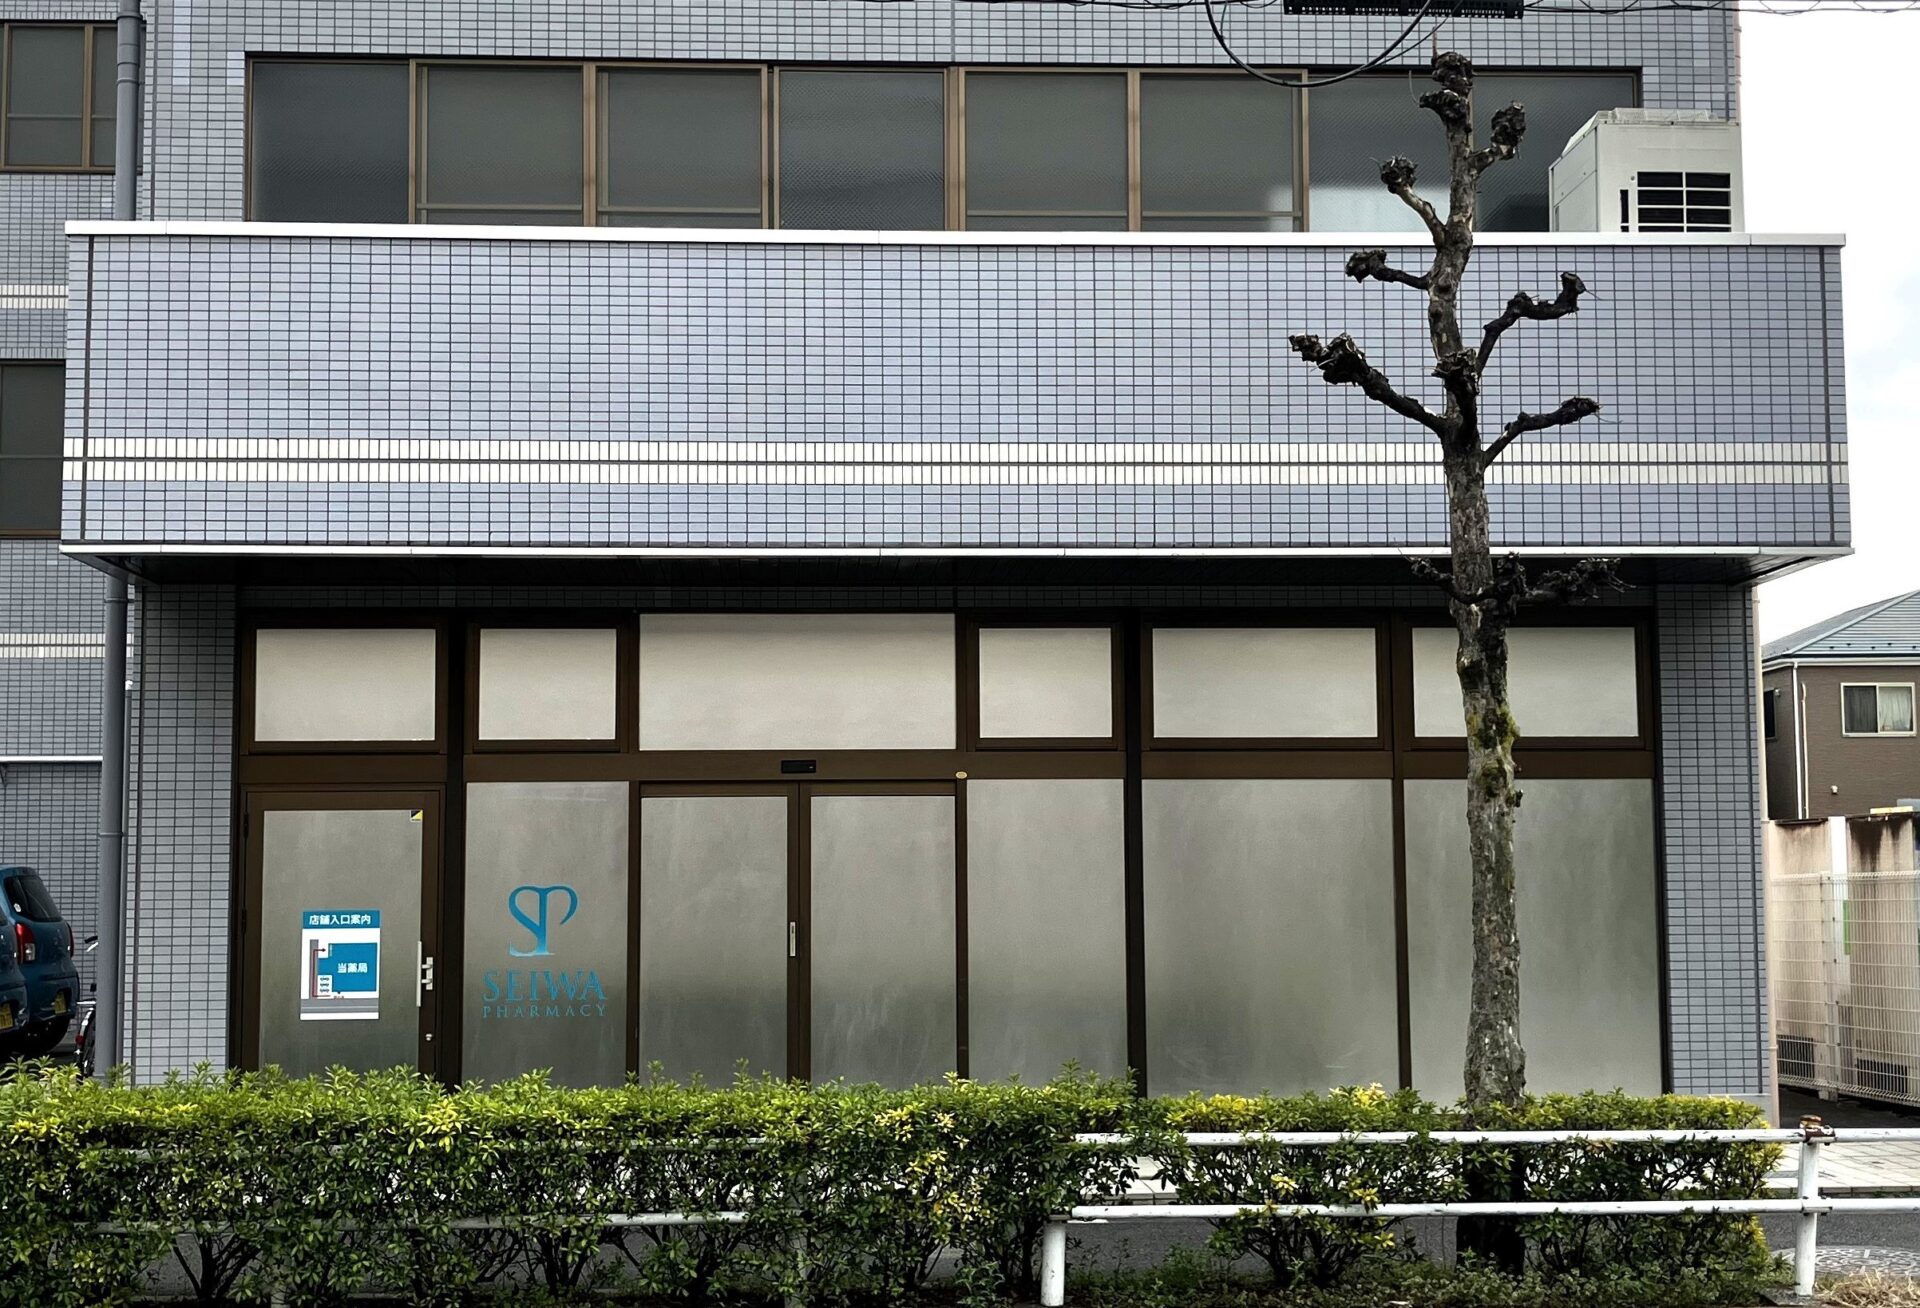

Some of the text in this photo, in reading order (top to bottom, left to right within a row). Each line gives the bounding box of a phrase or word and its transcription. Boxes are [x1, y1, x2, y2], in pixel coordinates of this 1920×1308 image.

[308, 914, 372, 925] 店舗入口案内
[337, 962, 368, 973] 当薬局
[482, 969, 607, 1001] SEIWA
[482, 1004, 608, 1018] PHARMACY
